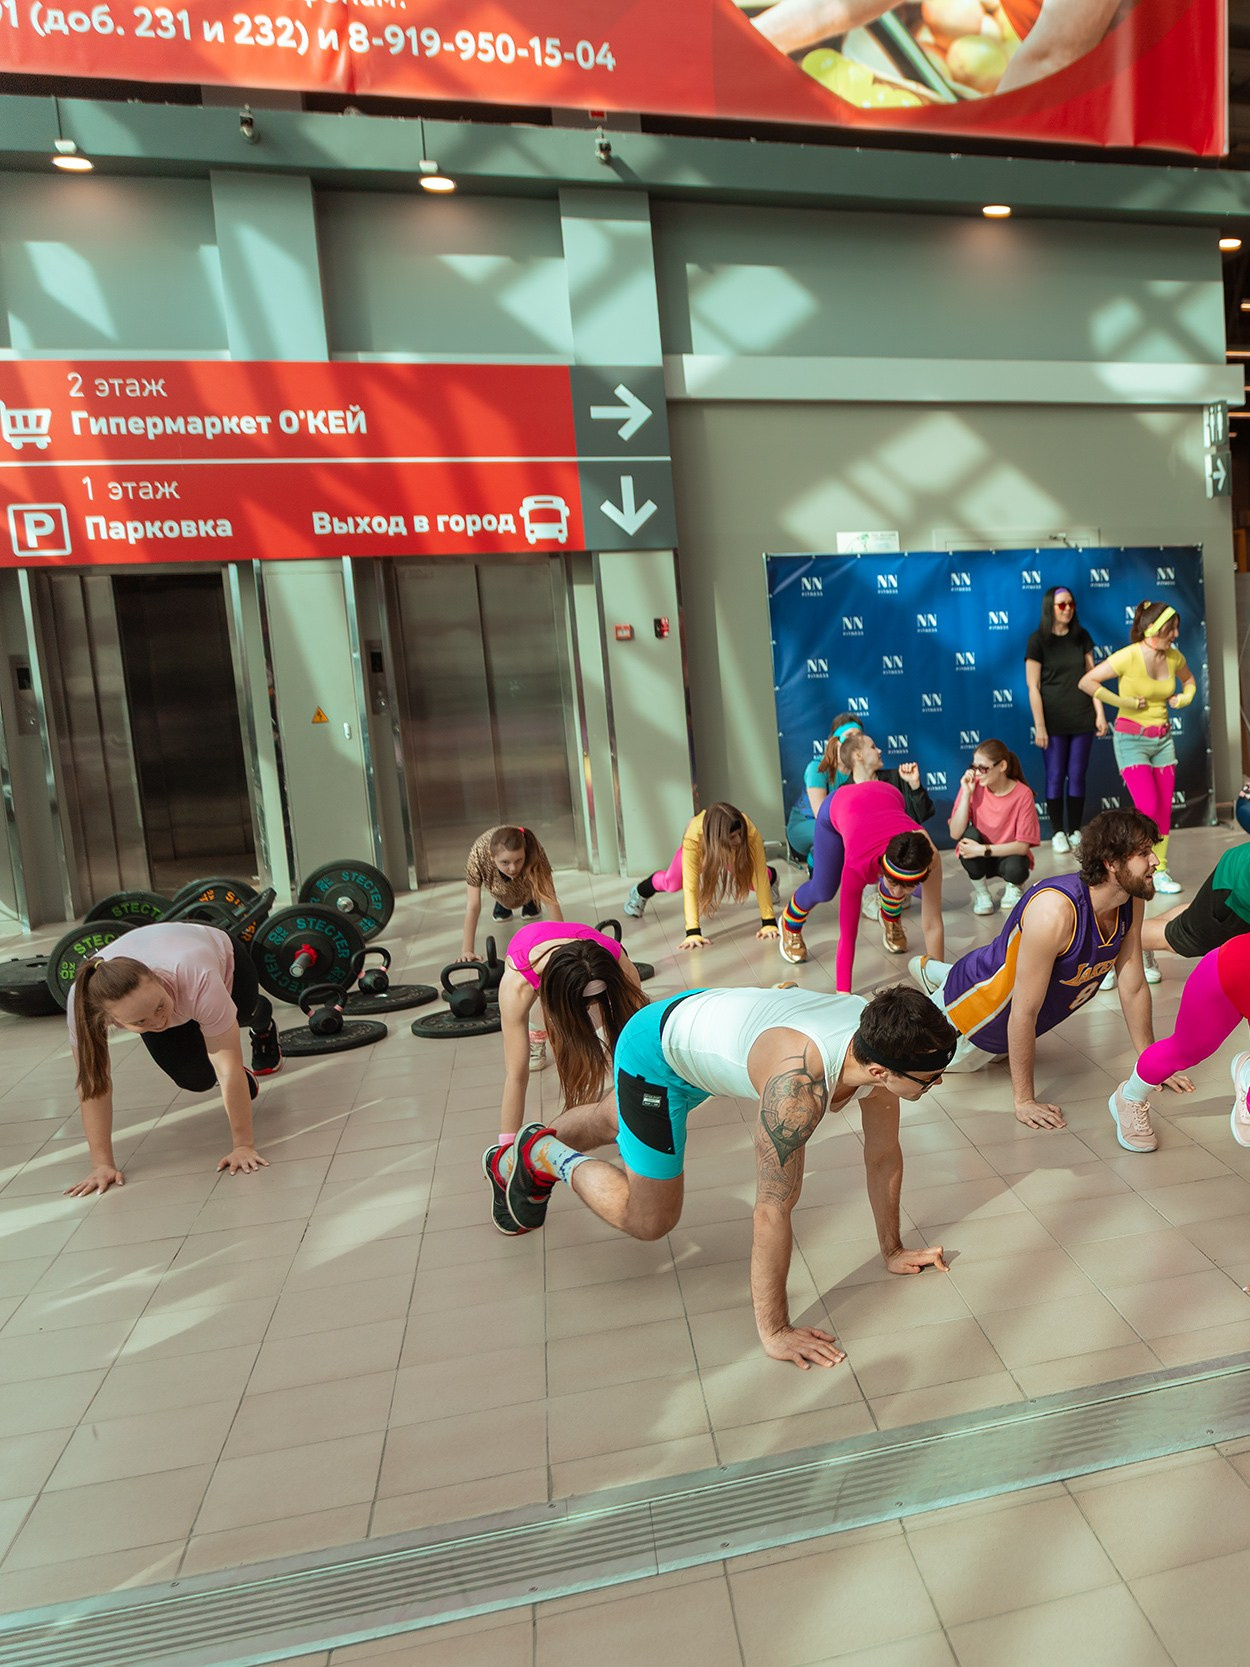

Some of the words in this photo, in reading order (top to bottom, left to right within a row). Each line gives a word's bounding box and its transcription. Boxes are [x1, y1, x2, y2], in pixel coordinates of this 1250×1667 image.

[0, 0, 19, 28] 1
[30, 1, 125, 37] (доб.
[133, 7, 191, 41] 231
[203, 19, 225, 43] и
[232, 12, 309, 56] 232)
[318, 28, 339, 51] и
[348, 21, 617, 72] 8-919-950-15-04
[67, 372, 84, 397] 2
[94, 377, 168, 398] этаж
[70, 411, 271, 440] Гипермаркет
[279, 404, 367, 434] О'КЕЙ
[82, 476, 94, 500] 1
[107, 480, 181, 500] этаж
[85, 515, 233, 545] Парковка
[312, 511, 408, 537] Выход
[413, 516, 430, 533] в
[437, 513, 516, 537] город
[877, 575, 898, 588] NN
[951, 573, 971, 586] NN
[1022, 570, 1041, 584] NN
[1090, 569, 1109, 582] NN
[801, 577, 822, 590] NN
[843, 617, 863, 630] NN
[917, 614, 937, 627] NN
[989, 611, 1008, 624] NN
[883, 656, 903, 669] NN
[956, 652, 975, 665] NN
[807, 659, 828, 672] NN
[922, 693, 942, 706] NN
[993, 689, 1013, 702] NN
[848, 697, 869, 710] NN
[888, 735, 908, 748] NN
[960, 730, 980, 743] NN
[926, 772, 946, 785] NN
[1102, 797, 1120, 809] NN
[341, 871, 383, 911] STECTER
[112, 902, 165, 920] STECT
[73, 933, 115, 955] STEC
[296, 917, 350, 958] STECTER
